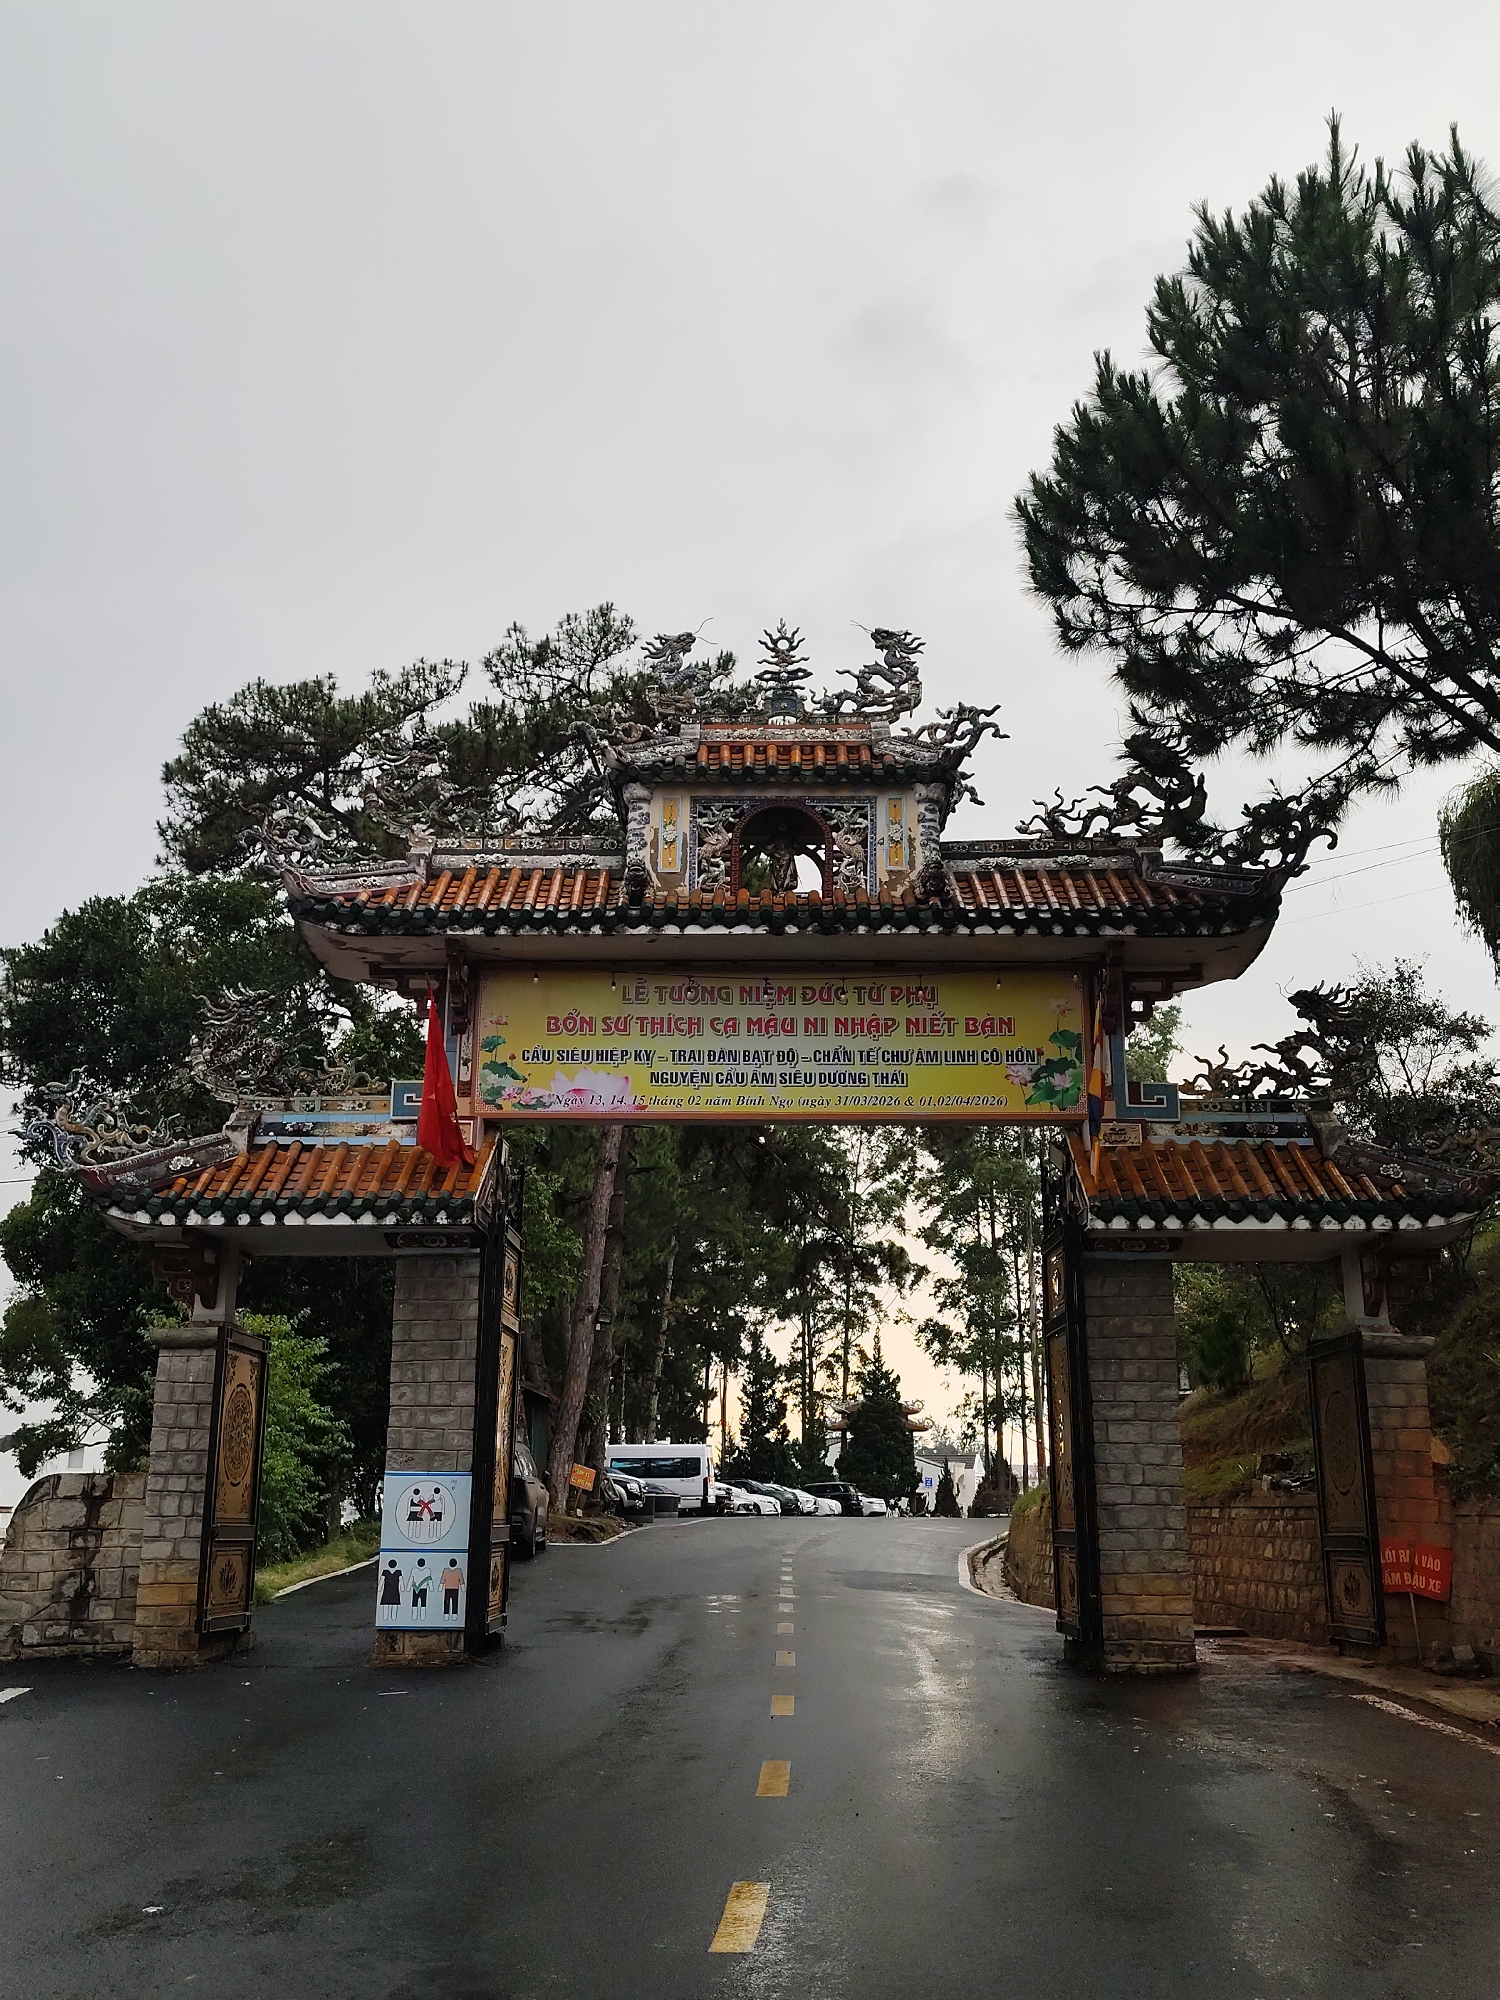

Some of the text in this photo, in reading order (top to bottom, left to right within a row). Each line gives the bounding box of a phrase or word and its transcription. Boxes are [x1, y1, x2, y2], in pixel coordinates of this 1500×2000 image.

[621, 978, 938, 1009] LỄ TƯỞNG NIỆM ĐỨC TỪ PHỤ
[546, 1008, 1015, 1041] BỔN SƯ THÍCH CA MÂU NI NHẬP NIẾT BÀN
[521, 1044, 553, 1064] CẦU
[556, 1047, 593, 1064] SIÊU
[596, 1047, 632, 1067] HIỆP
[670, 1049, 704, 1065] TRAI
[706, 1047, 740, 1065] ĐÀN
[742, 1049, 774, 1068] BẠT
[775, 1047, 799, 1068] ĐỘ
[813, 1044, 855, 1065] CHẨN
[857, 1046, 881, 1065] TẾ
[881, 1048, 914, 1065] CHƯ
[915, 1048, 942, 1065] ÂM
[944, 1049, 979, 1065] LINH
[980, 1048, 1002, 1065] CÔ
[1005, 1045, 1040, 1065] HỒN
[650, 1067, 908, 1090] NGUYỆN CẦU ÂM SIÊU DƯƠNG THÁI
[553, 1094, 1008, 1108] Ngày 13, 14, 15 tháng 02 năm Bính Ngọ (ngày 31/03/2026 & 01,02/04/2026)
[1421, 1553, 1441, 1571] VÀO
[1382, 1569, 1401, 1586] ẤM
[1428, 1578, 1441, 1593] XE
